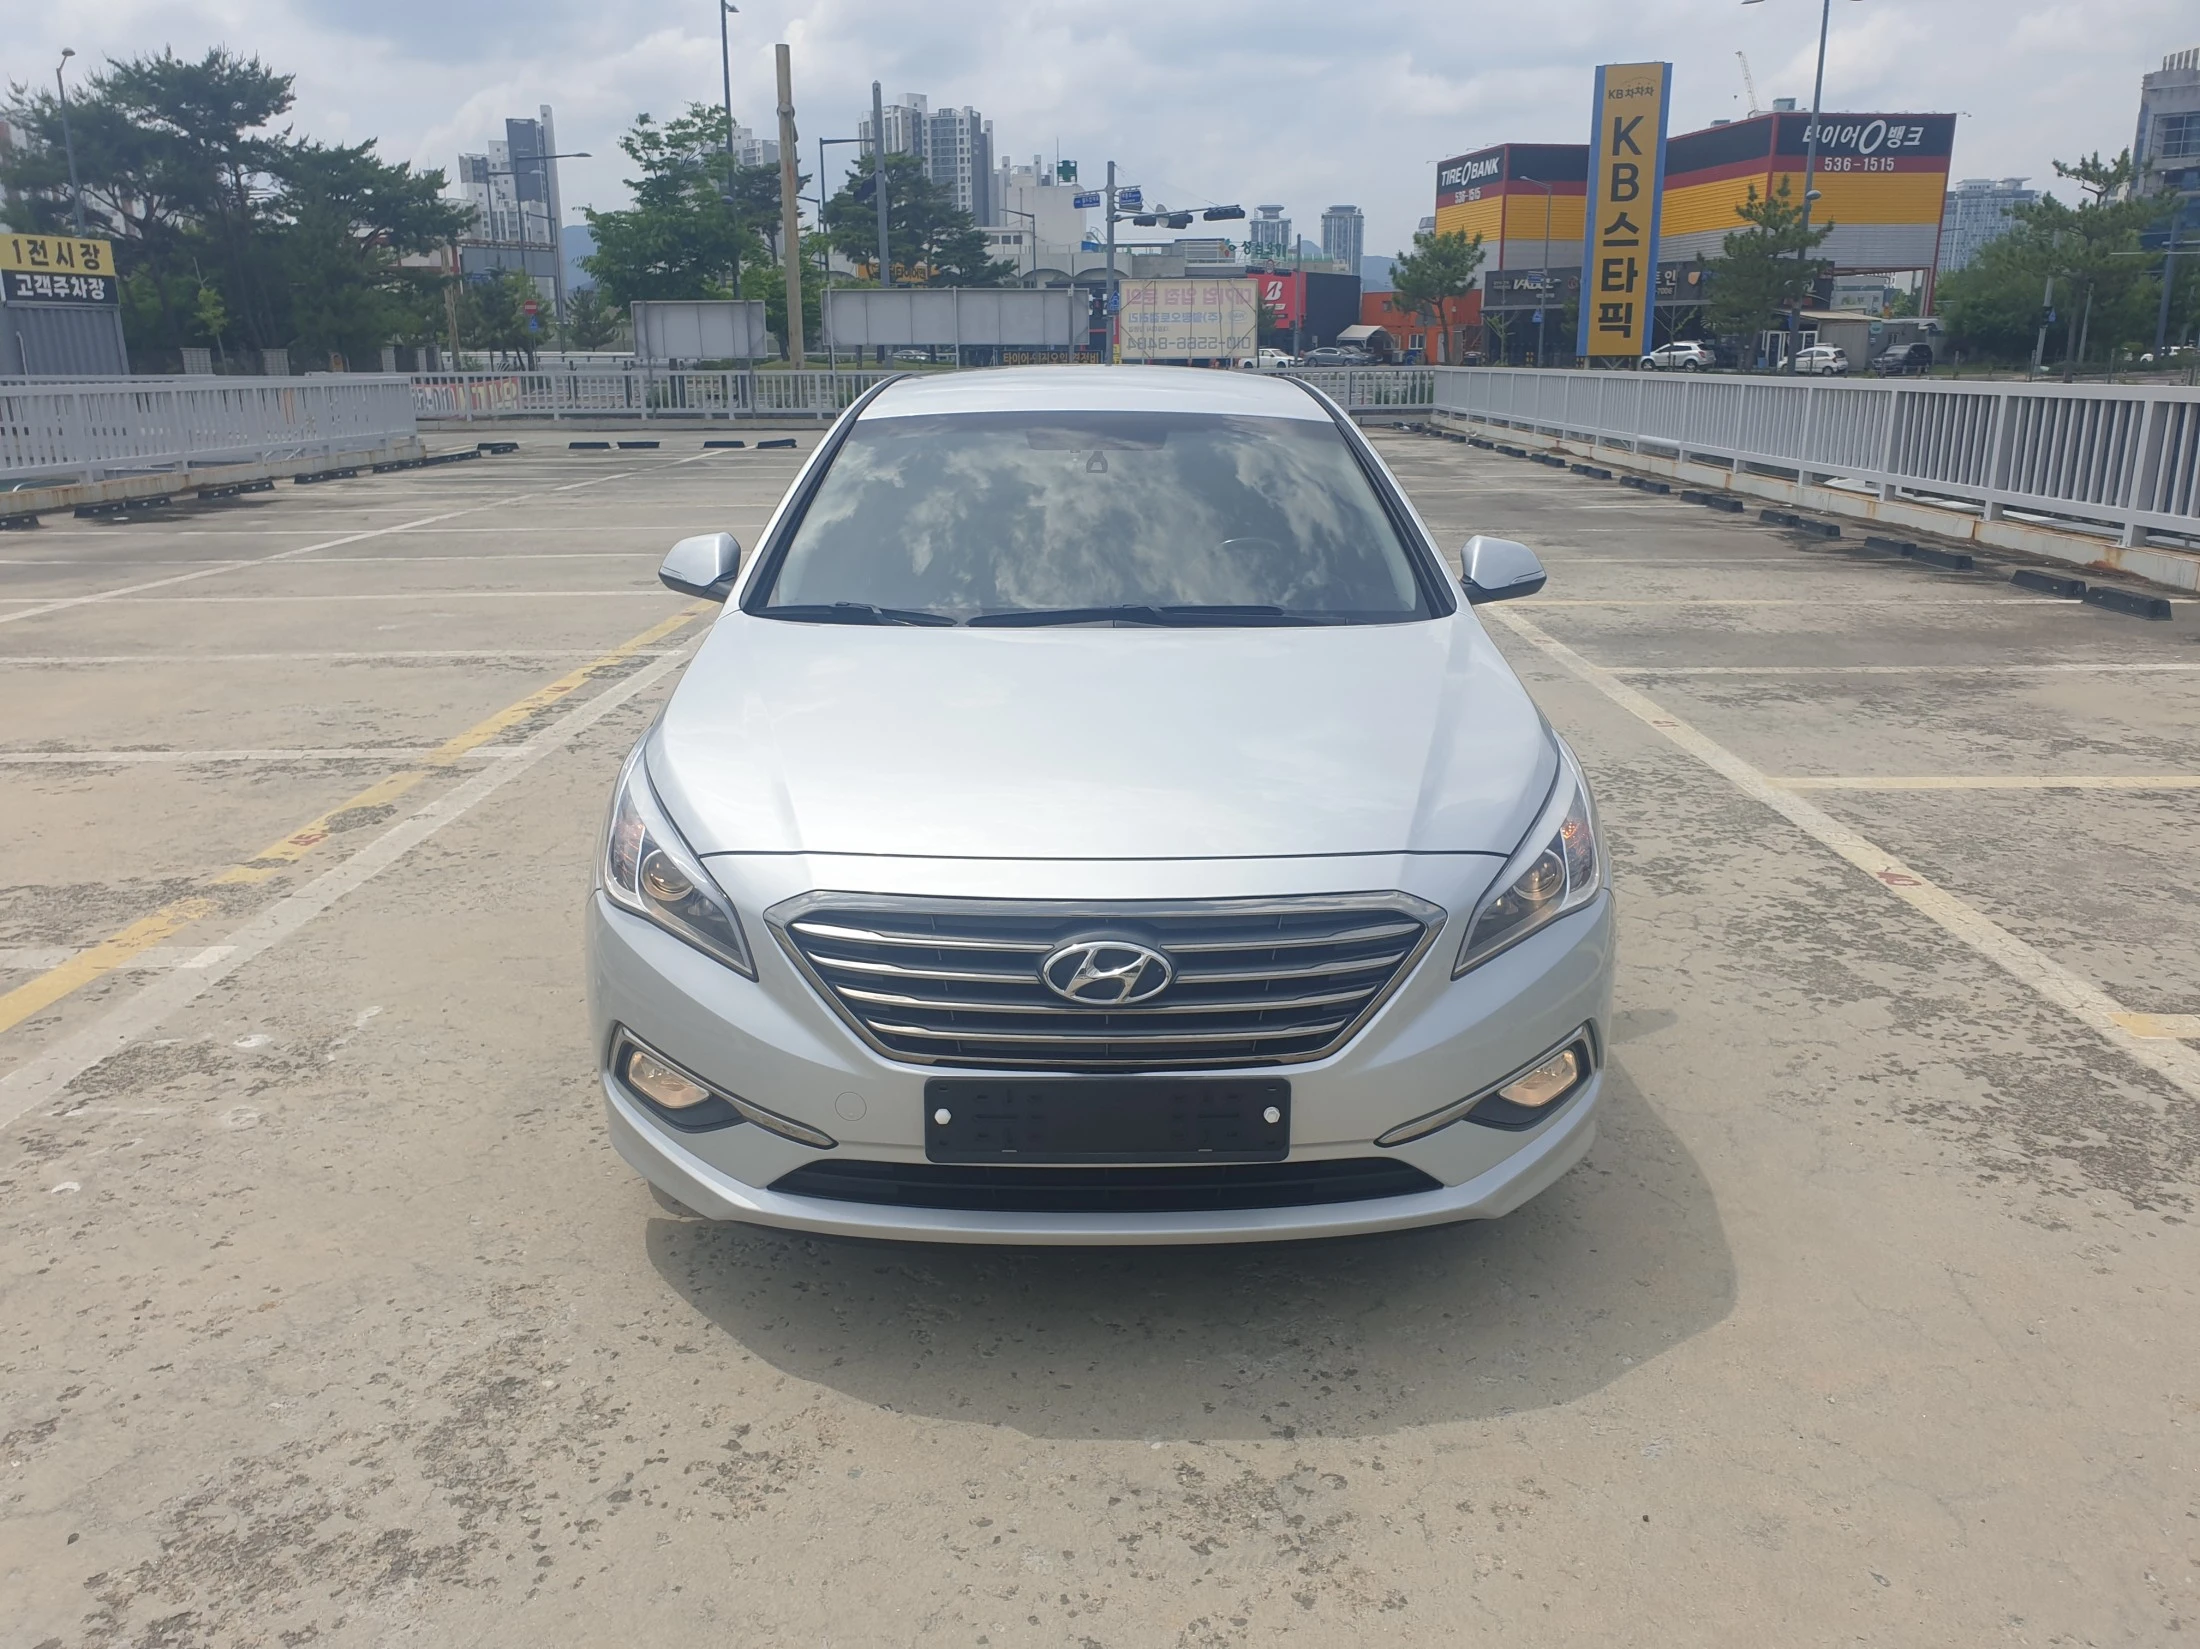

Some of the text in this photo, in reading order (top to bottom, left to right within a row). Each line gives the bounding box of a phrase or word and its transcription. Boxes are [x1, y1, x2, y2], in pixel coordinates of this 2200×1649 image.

[1824, 157, 1895, 171] 536-1515
[1598, 115, 1645, 338] KB스타픽
[15, 274, 105, 300] 고객주차장
